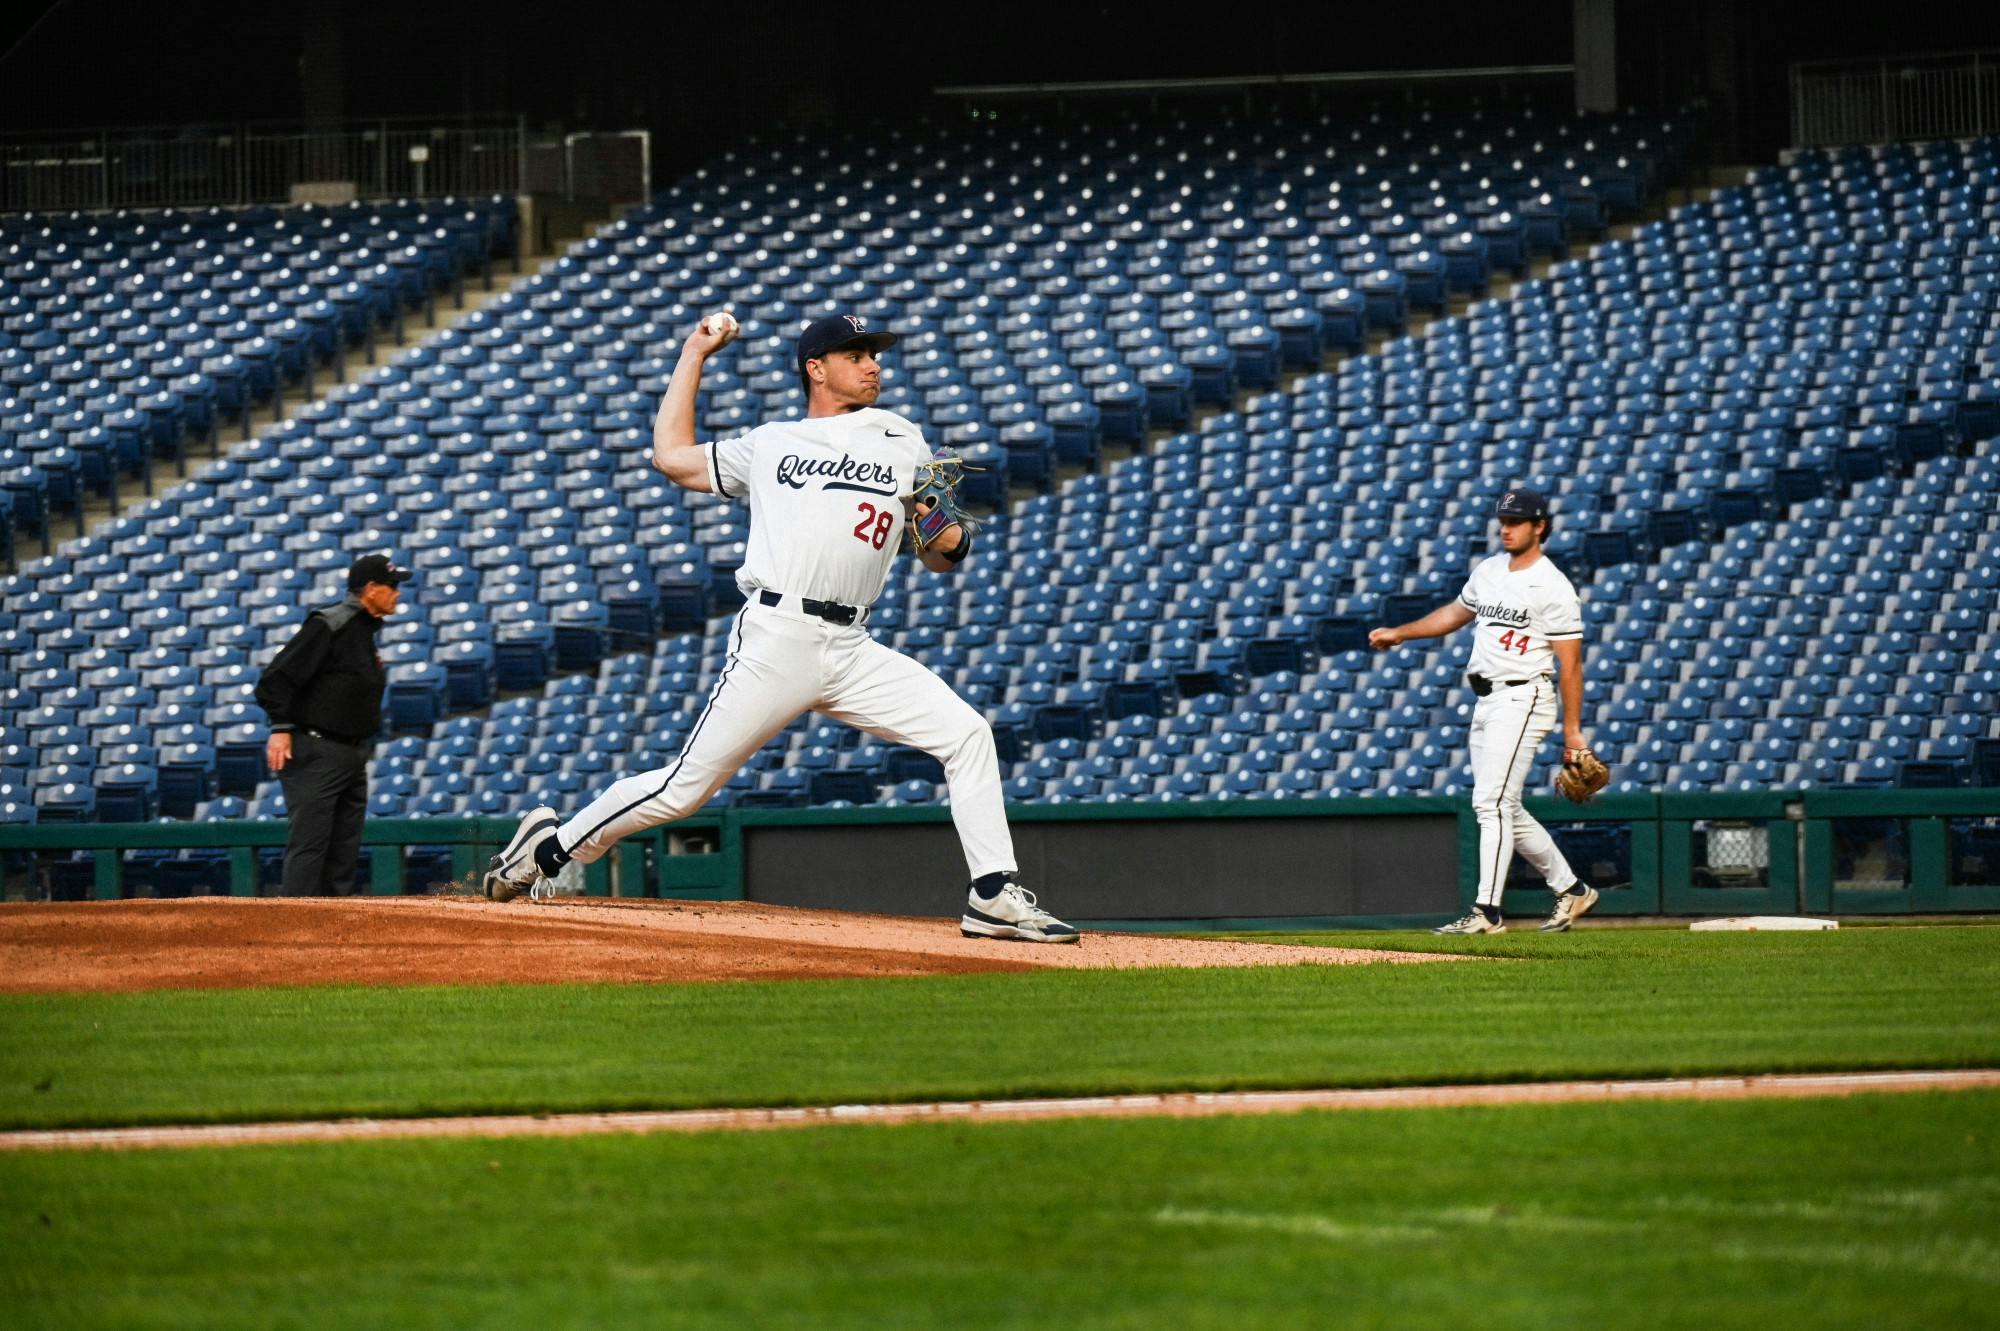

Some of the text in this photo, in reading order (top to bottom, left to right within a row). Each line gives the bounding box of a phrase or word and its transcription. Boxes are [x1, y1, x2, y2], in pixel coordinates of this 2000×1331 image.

[776, 453, 898, 497] Quakers
[853, 502, 894, 551] 28
[1476, 601, 1532, 630] uakers
[1498, 630, 1531, 656] 44
